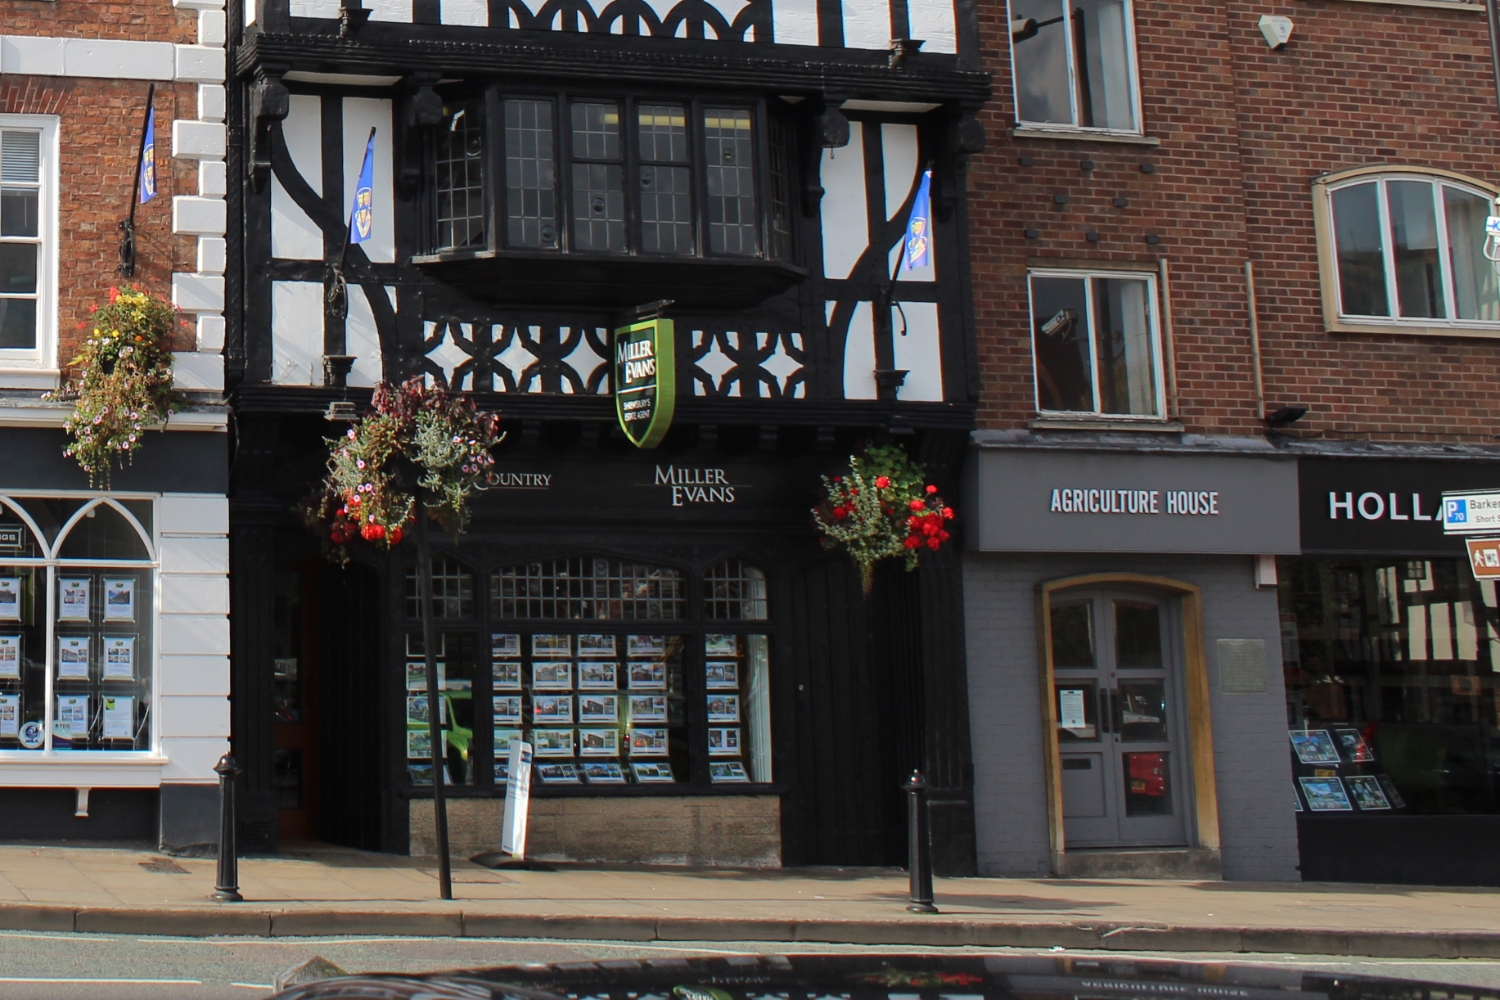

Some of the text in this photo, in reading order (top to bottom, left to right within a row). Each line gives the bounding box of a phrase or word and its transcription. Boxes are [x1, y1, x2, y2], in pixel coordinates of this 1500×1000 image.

[617, 340, 653, 363] MILLER
[625, 359, 655, 383] EVANS
[654, 464, 729, 485] MILLER
[671, 486, 735, 507] EVANS
[1051, 488, 1219, 515] AGRICULTURE HOUSE
[1454, 512, 1465, 521] 70
[1475, 514, 1496, 523] Short
